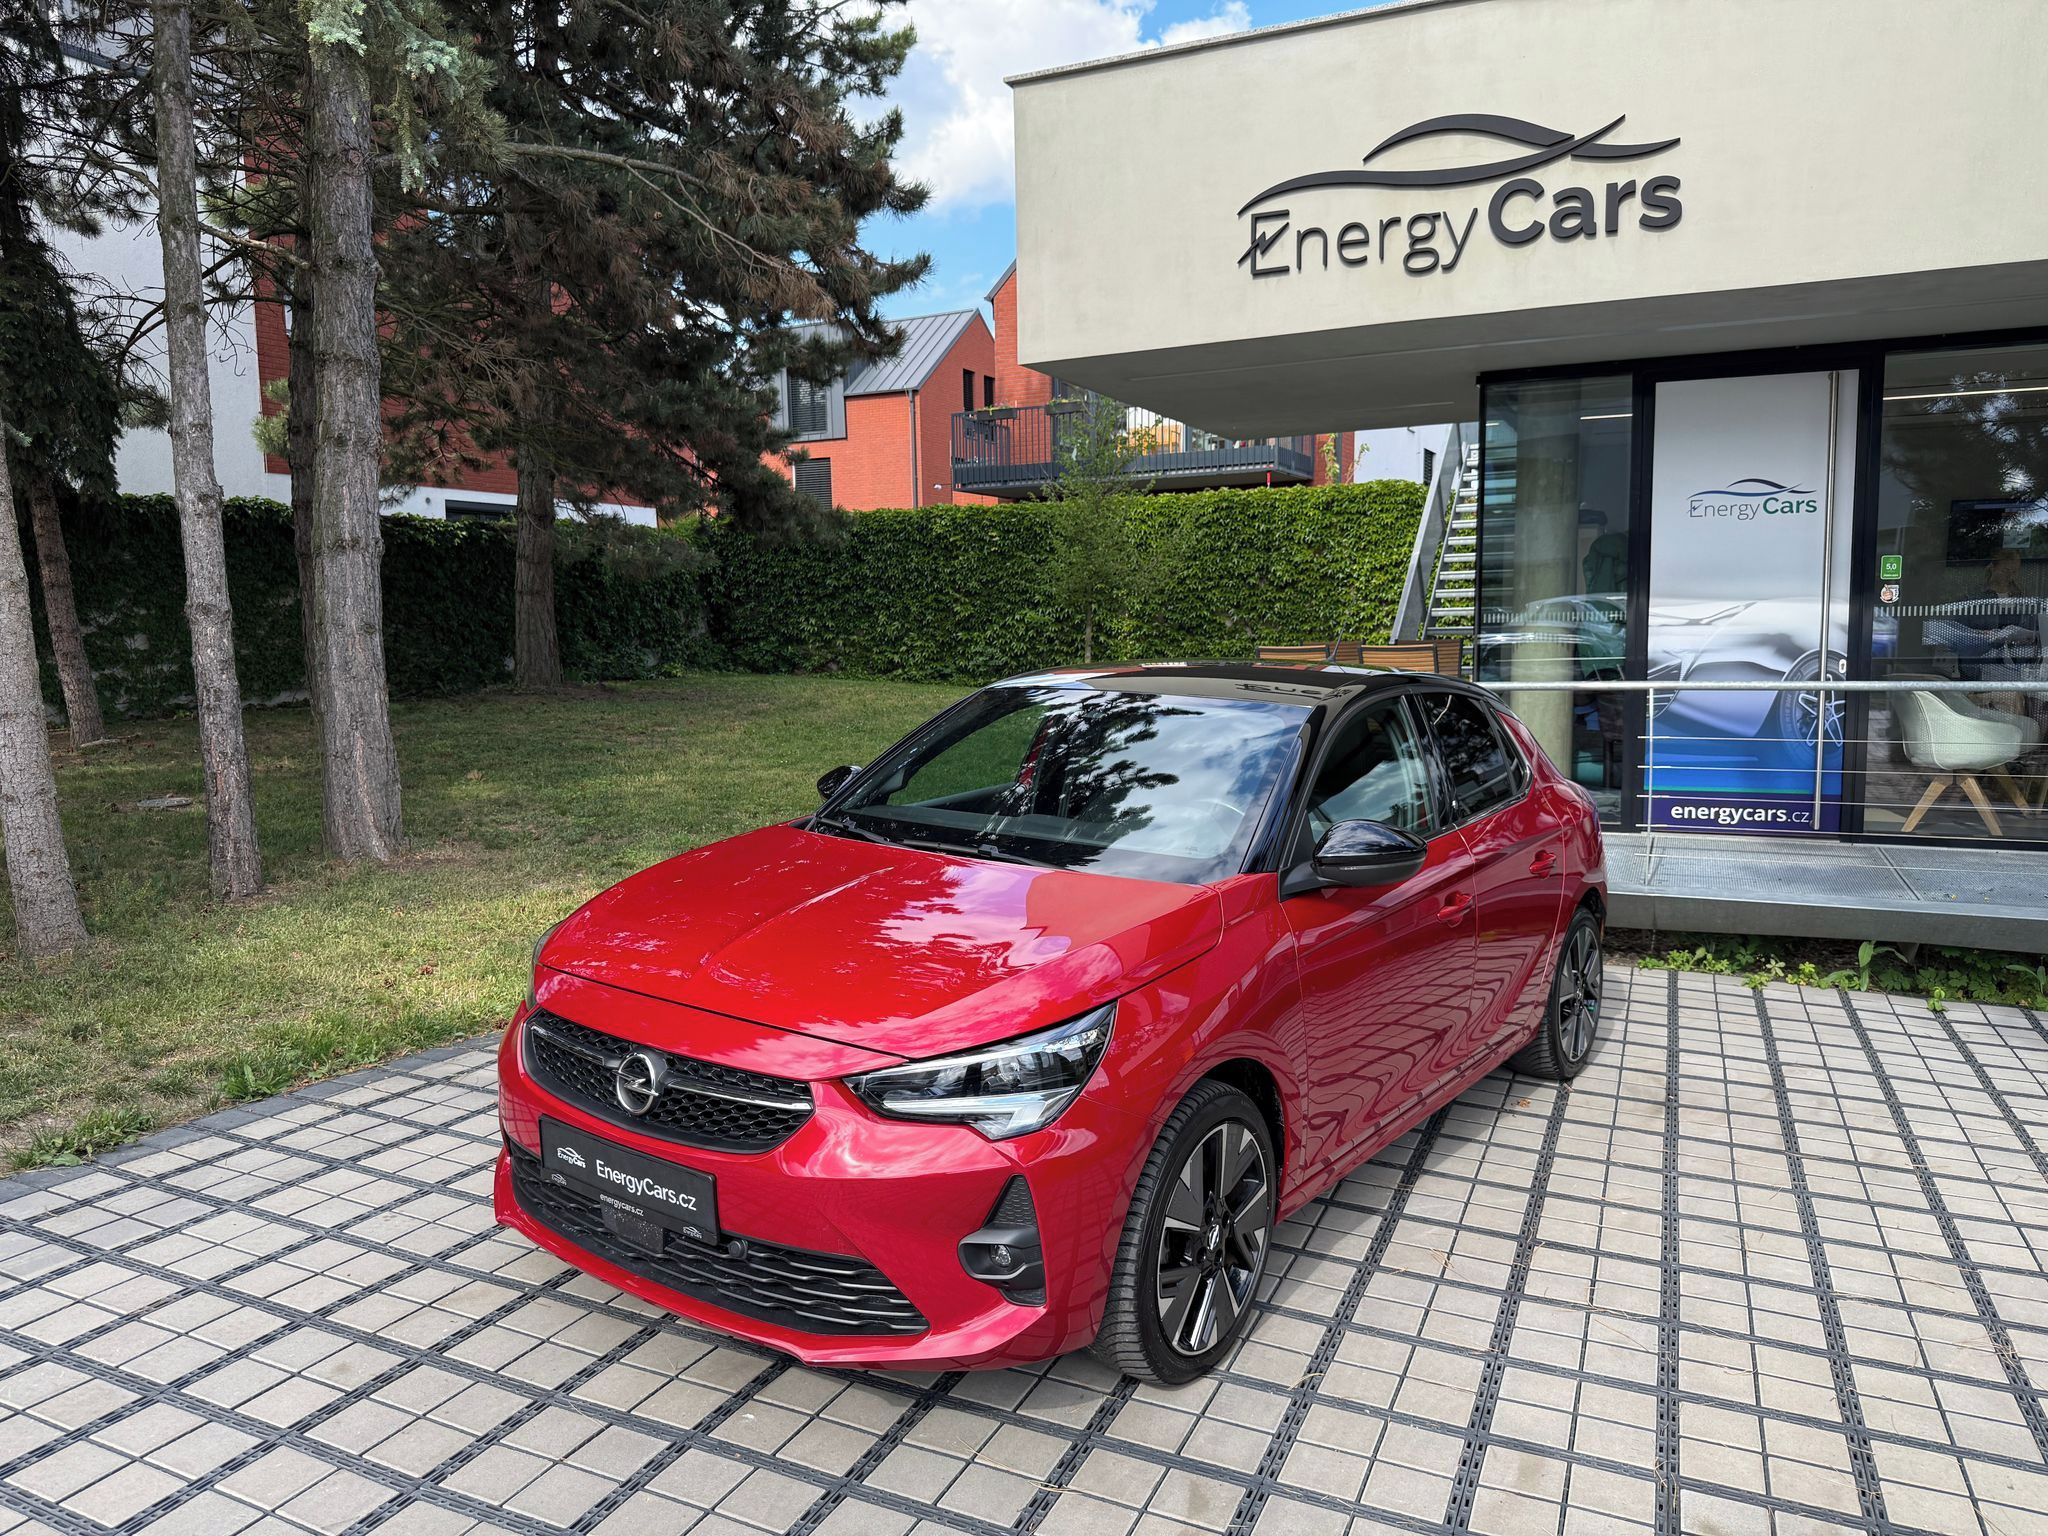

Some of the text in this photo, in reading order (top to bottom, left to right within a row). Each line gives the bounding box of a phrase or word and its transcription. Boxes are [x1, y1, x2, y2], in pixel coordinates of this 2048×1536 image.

[1671, 806, 1810, 824] energycars.cz
[596, 1159, 697, 1211] EnergyCars.cz
[600, 1193, 644, 1217] energycars.cz
